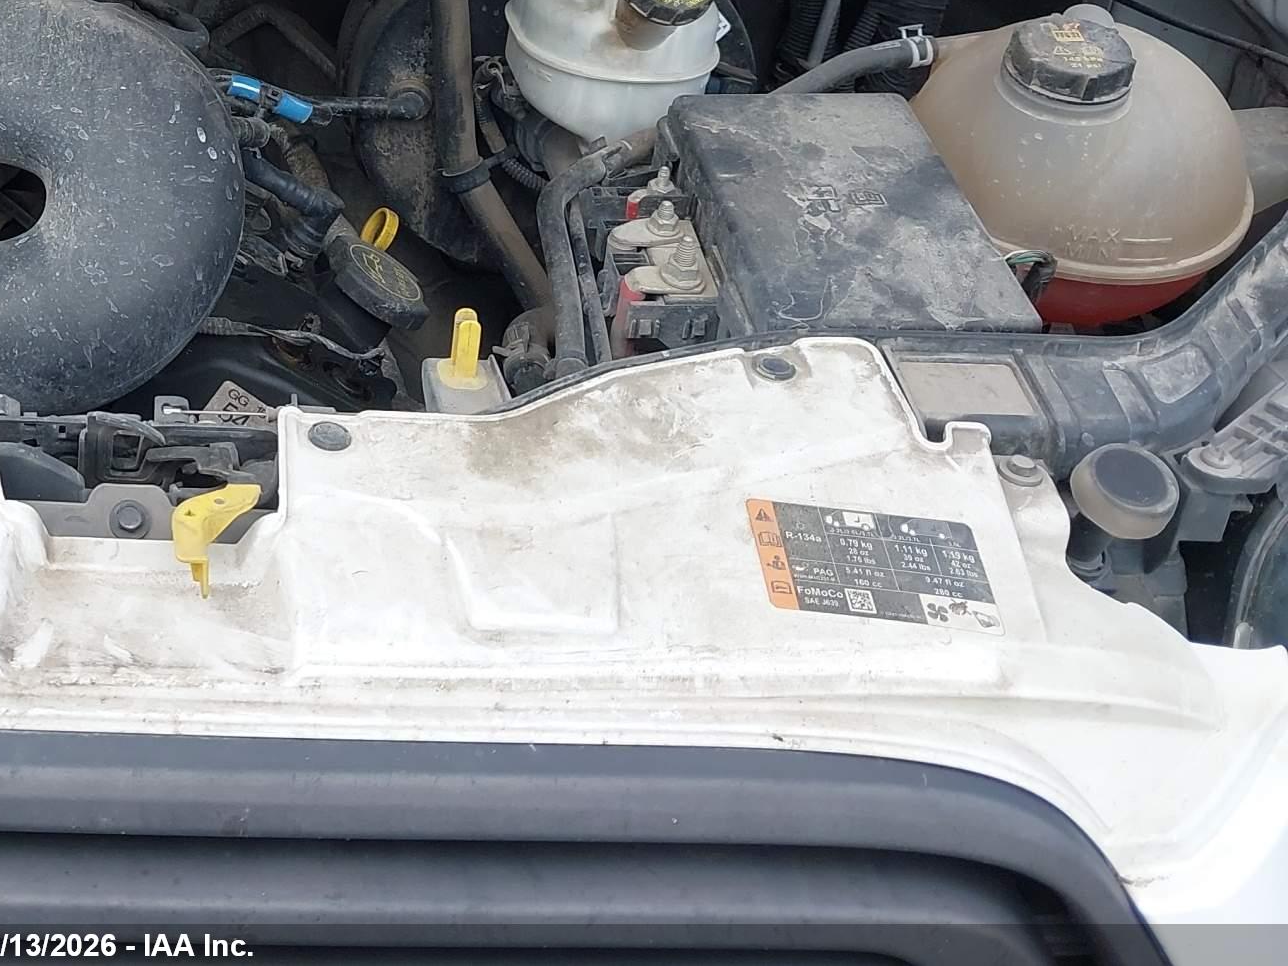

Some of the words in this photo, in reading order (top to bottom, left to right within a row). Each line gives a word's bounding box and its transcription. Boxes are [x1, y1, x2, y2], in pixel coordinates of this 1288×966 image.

[228, 389, 250, 406] GG
[785, 530, 822, 543] R-134a
[839, 537, 859, 548] 0.79
[860, 539, 873, 551] kg
[894, 544, 913, 554] 1.11
[915, 546, 928, 558] kg
[863, 557, 876, 565] lbs
[962, 552, 975, 564] kg
[918, 562, 931, 571] lbs
[962, 562, 972, 570] oz
[813, 567, 835, 577] PAG
[966, 569, 979, 578] lbs
[953, 580, 965, 588] oz
[797, 585, 844, 599] FoMoCo
[952, 590, 964, 598] cc
[804, 596, 820, 606] SAE
